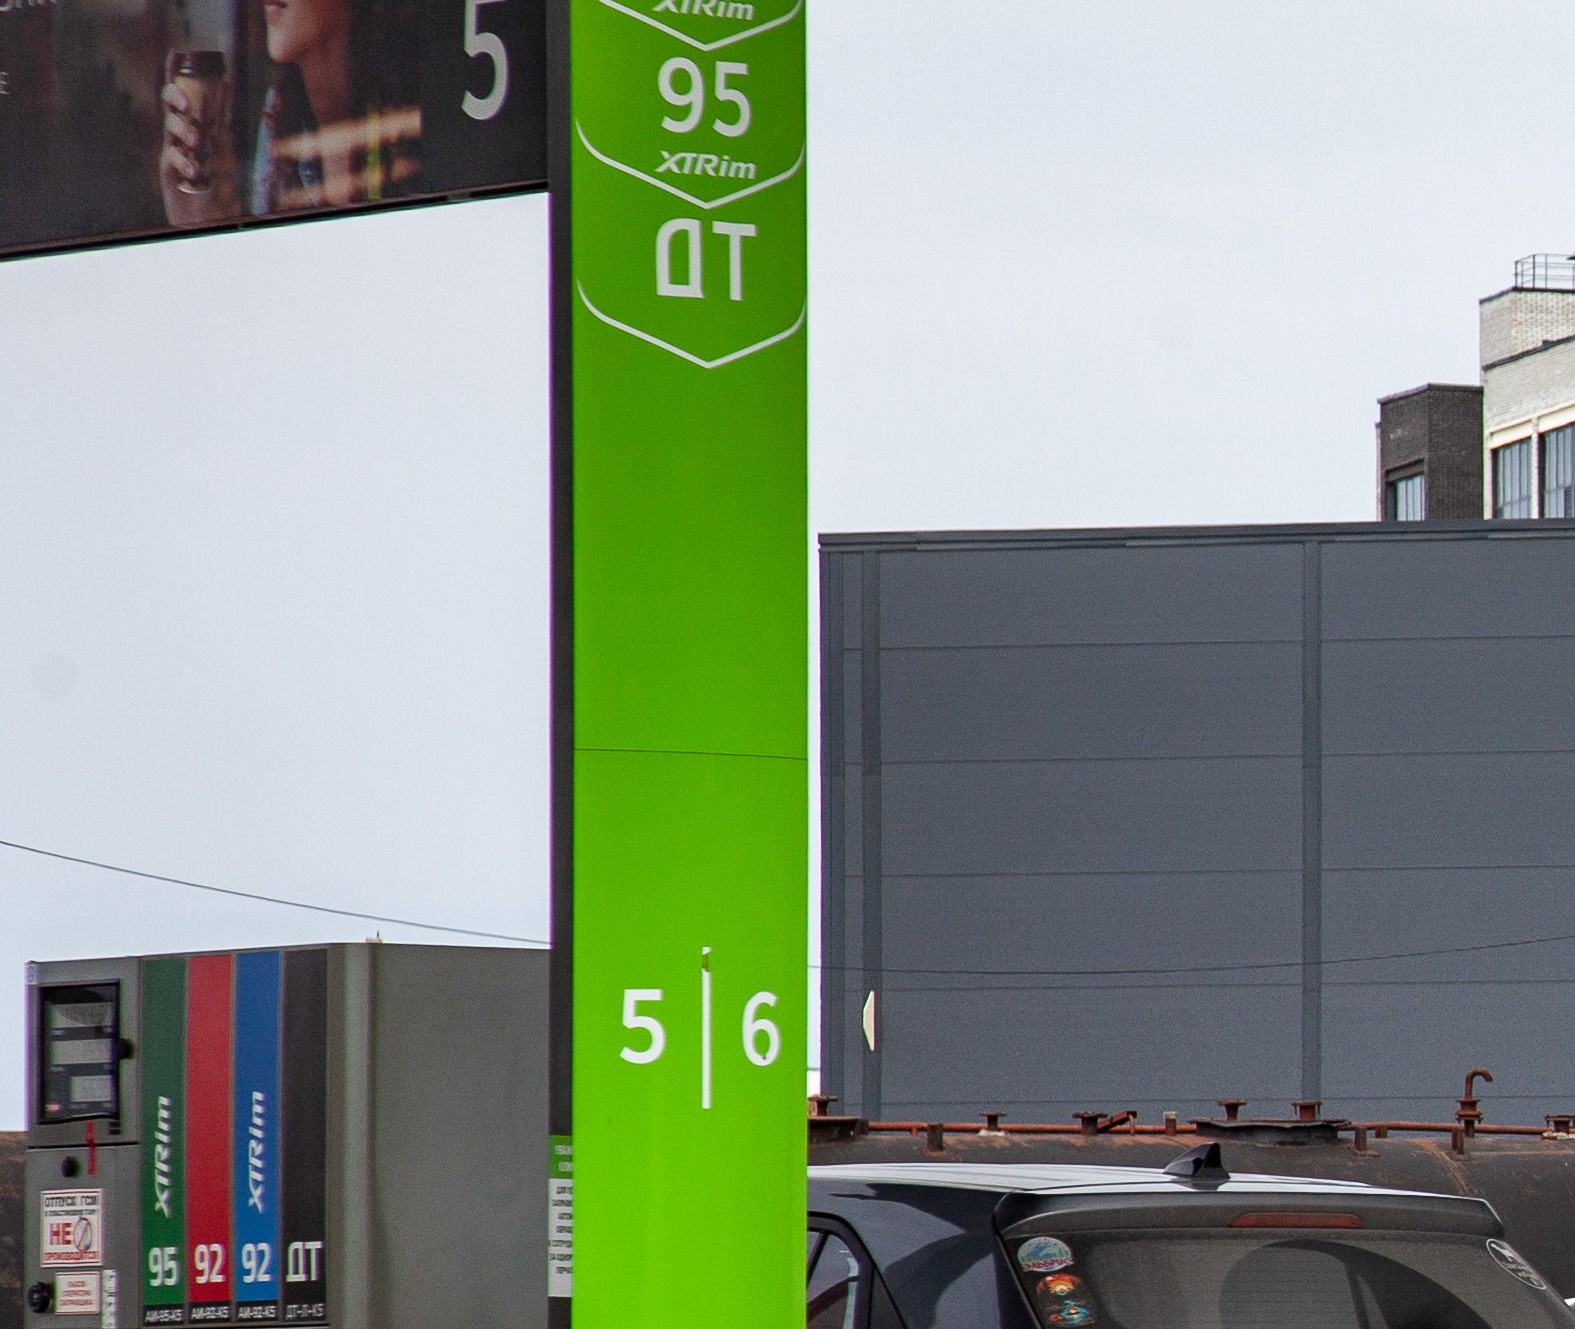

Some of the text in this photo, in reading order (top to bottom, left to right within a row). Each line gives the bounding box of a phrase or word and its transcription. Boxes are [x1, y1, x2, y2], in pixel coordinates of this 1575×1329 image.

[461, 0, 508, 120] 5
[657, 56, 752, 138] 95
[655, 150, 756, 180] XTRim
[656, 217, 758, 302] ДТ
[619, 988, 781, 1067] 5 6
[154, 1095, 172, 1219] XTRim
[248, 1090, 266, 1215] XTRim
[50, 1222, 72, 1245] НЕ
[194, 1243, 226, 1284] 92
[241, 1242, 272, 1284] 92
[286, 1241, 325, 1282] ДТ
[148, 1246, 178, 1287] 95
